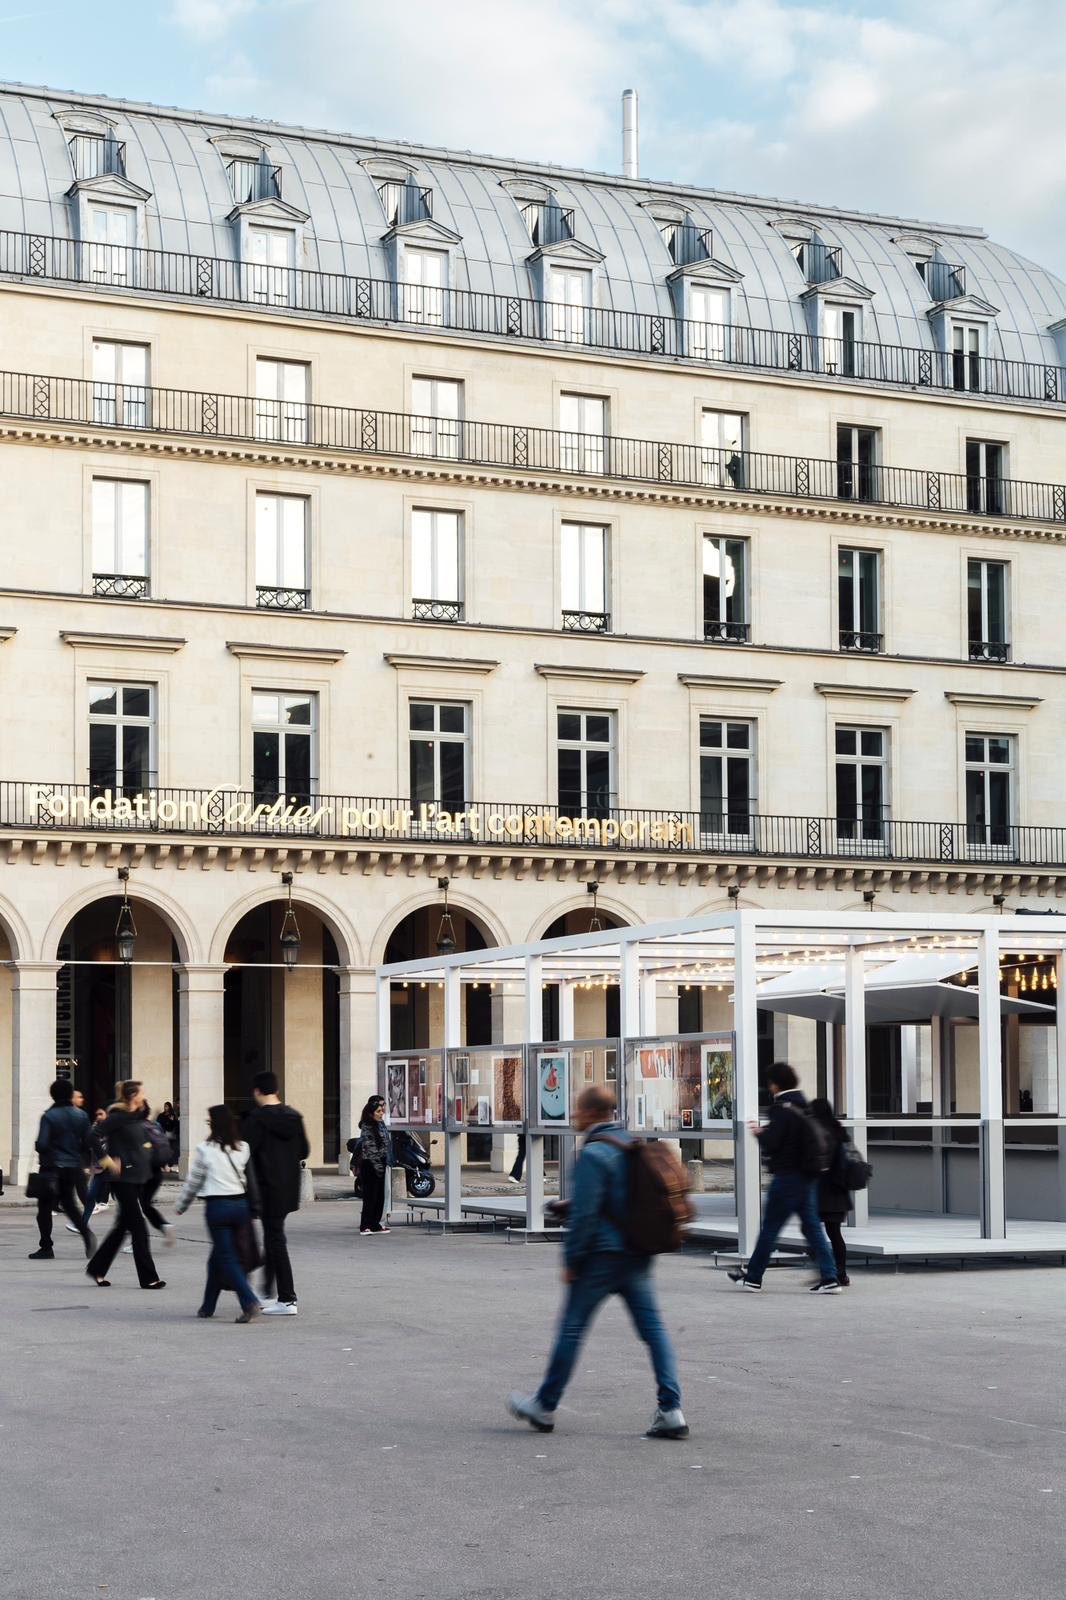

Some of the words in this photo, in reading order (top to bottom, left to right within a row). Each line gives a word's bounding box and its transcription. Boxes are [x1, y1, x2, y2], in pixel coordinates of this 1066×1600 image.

[29, 785, 200, 822] Fondation
[199, 783, 334, 828] Cartier
[342, 804, 413, 836] pour
[487, 813, 693, 846] contemporain
